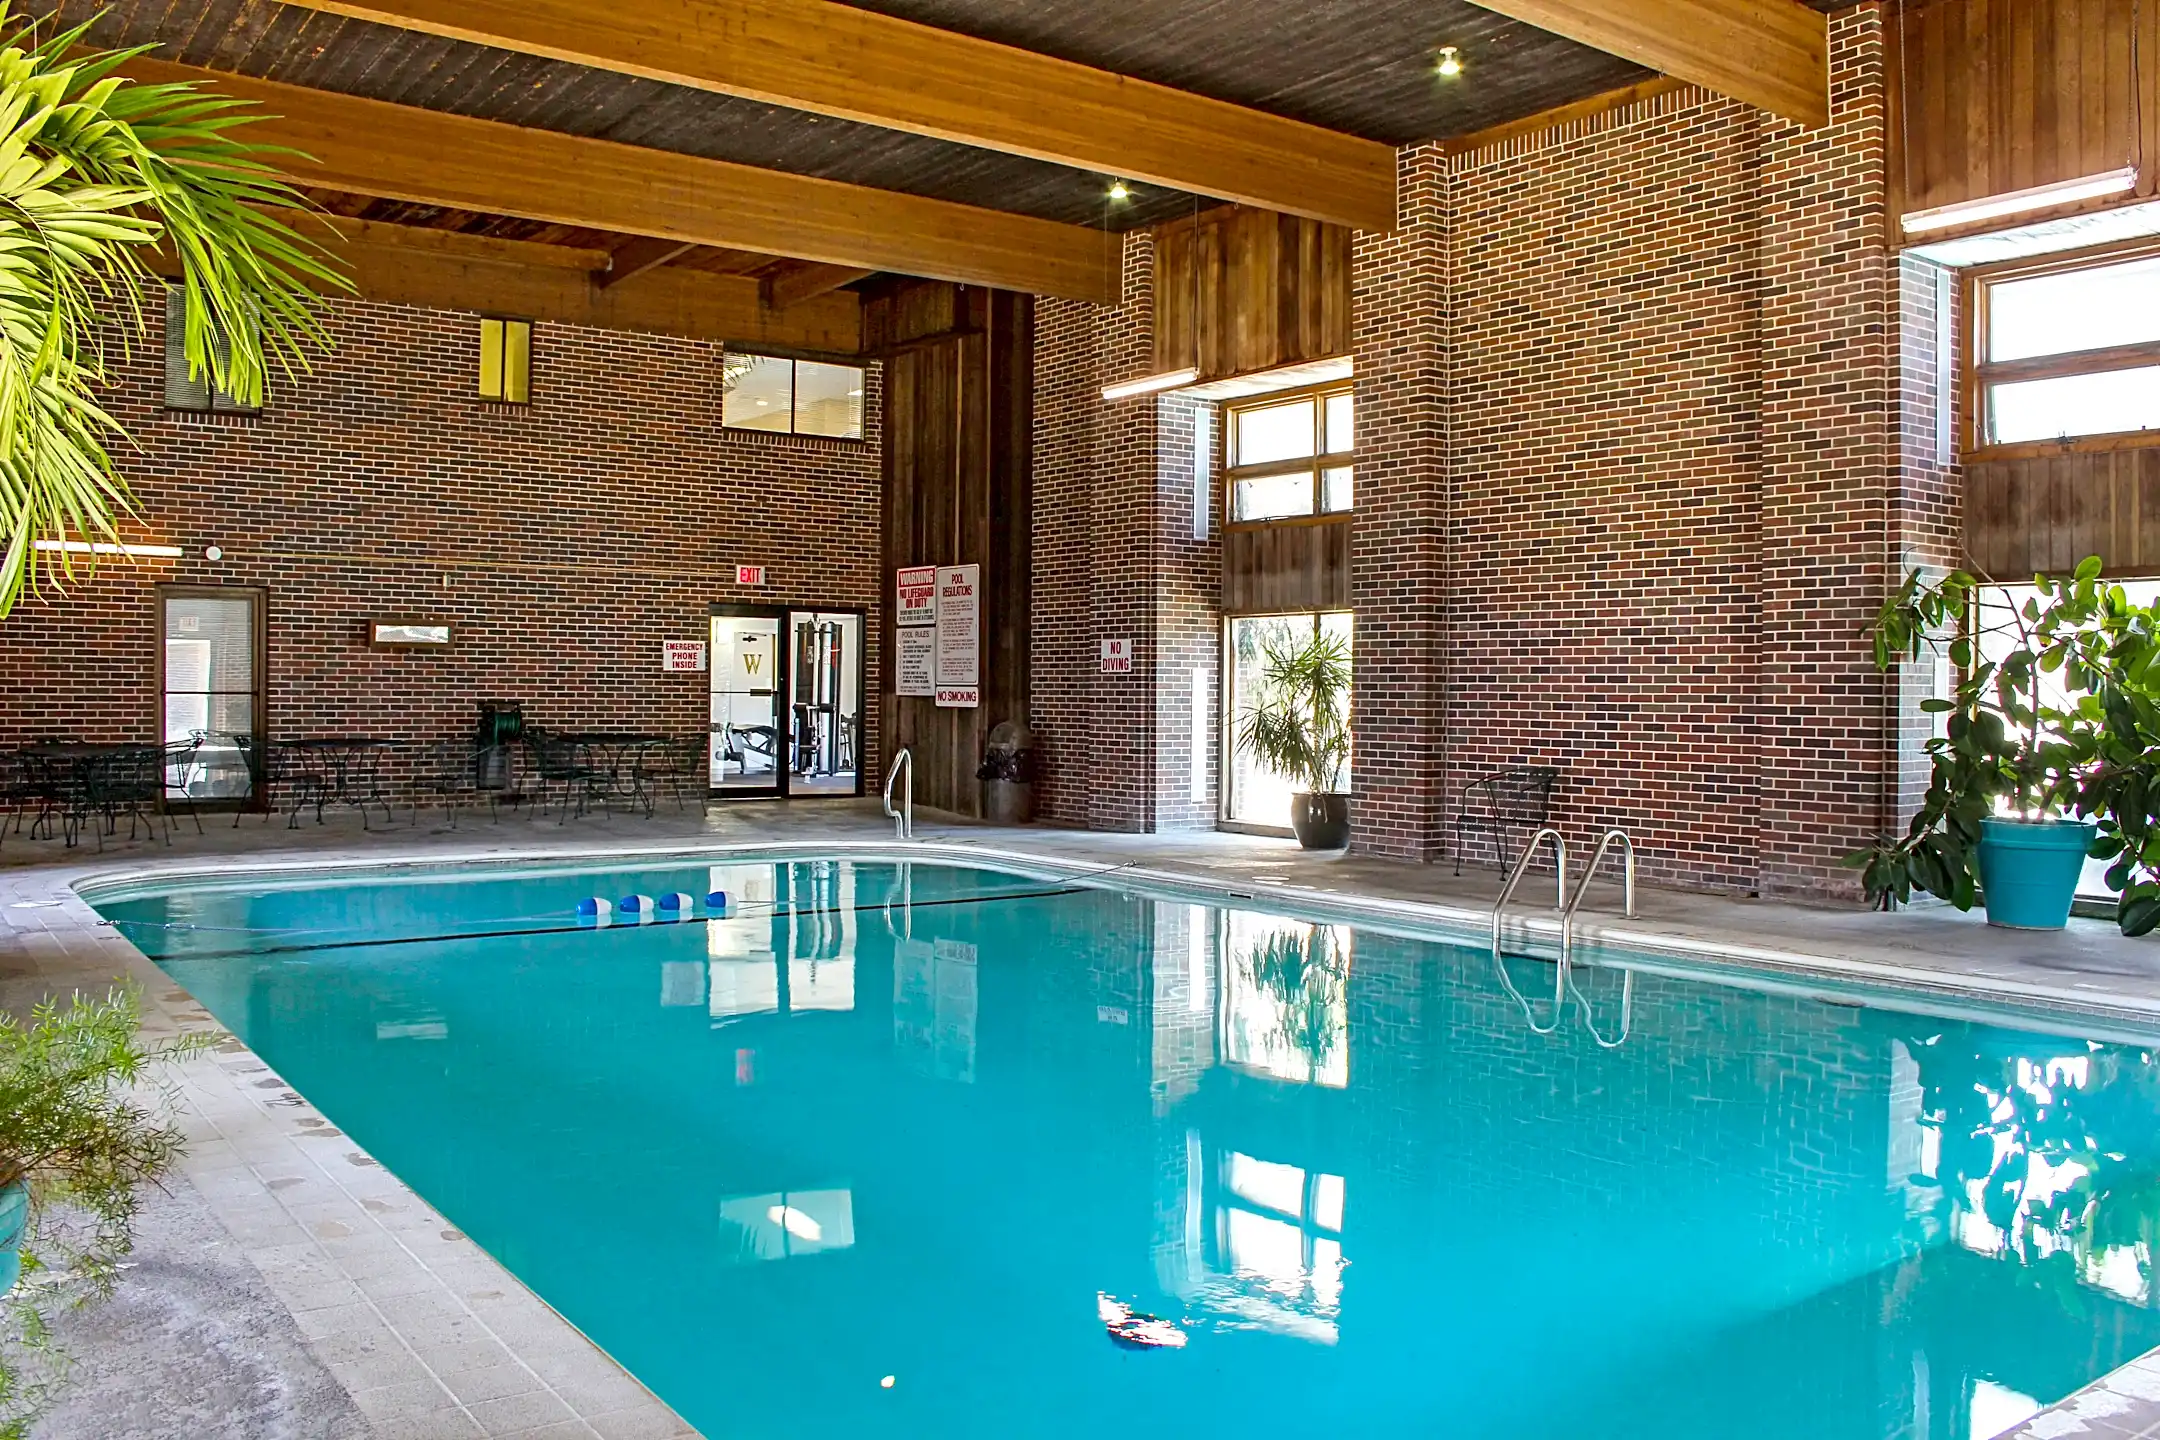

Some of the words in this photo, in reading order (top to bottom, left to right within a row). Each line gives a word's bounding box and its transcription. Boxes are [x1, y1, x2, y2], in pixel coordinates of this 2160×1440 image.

[740, 567, 761, 583] EXIT
[900, 570, 934, 585] WARNING
[951, 573, 964, 584] POOL
[900, 589, 907, 598] NO
[908, 587, 934, 598] LIFEGUARD
[942, 585, 973, 597] REGULATIONS
[905, 599, 913, 608] ON
[914, 598, 927, 608] DUTY
[914, 630, 931, 638] RULES
[665, 643, 704, 651] EMERGENCY
[1110, 641, 1122, 654] NO
[672, 652, 698, 660] PHONE
[672, 661, 697, 669] INSIDE
[743, 654, 762, 674] W
[1102, 658, 1129, 671] DIVING
[937, 691, 947, 702] NO
[947, 691, 977, 702] SMOKING
